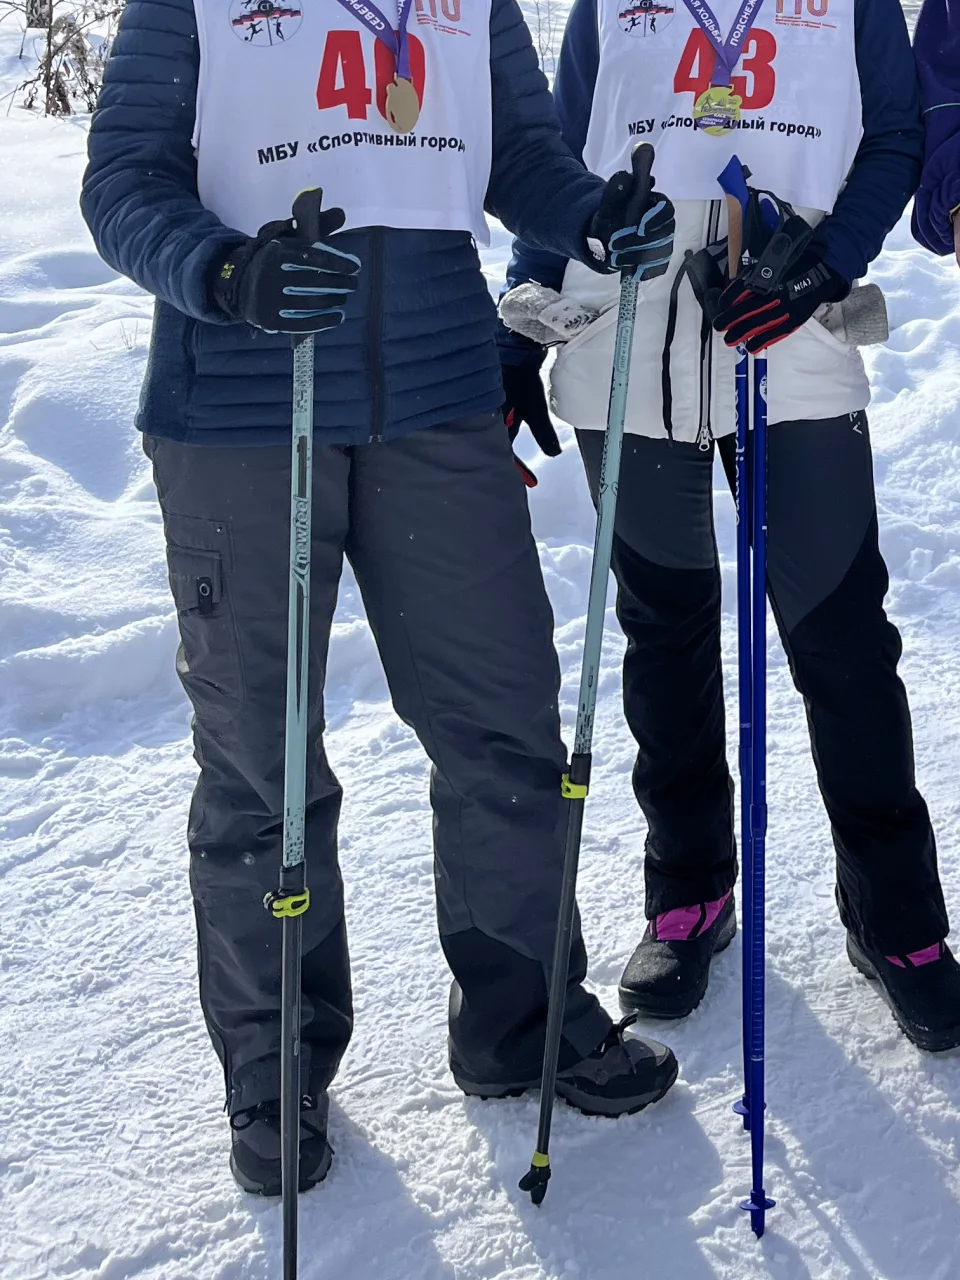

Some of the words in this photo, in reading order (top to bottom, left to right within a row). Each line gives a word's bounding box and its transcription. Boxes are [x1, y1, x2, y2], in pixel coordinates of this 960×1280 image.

[696, 7, 722, 43] ХОДЬБА
[316, 30, 426, 121] 40
[673, 27, 777, 111] 43
[257, 140, 299, 165] МБУ
[307, 130, 417, 156] «Спортивный
[770, 119, 822, 138] город»
[292, 494, 309, 564] newfeel
